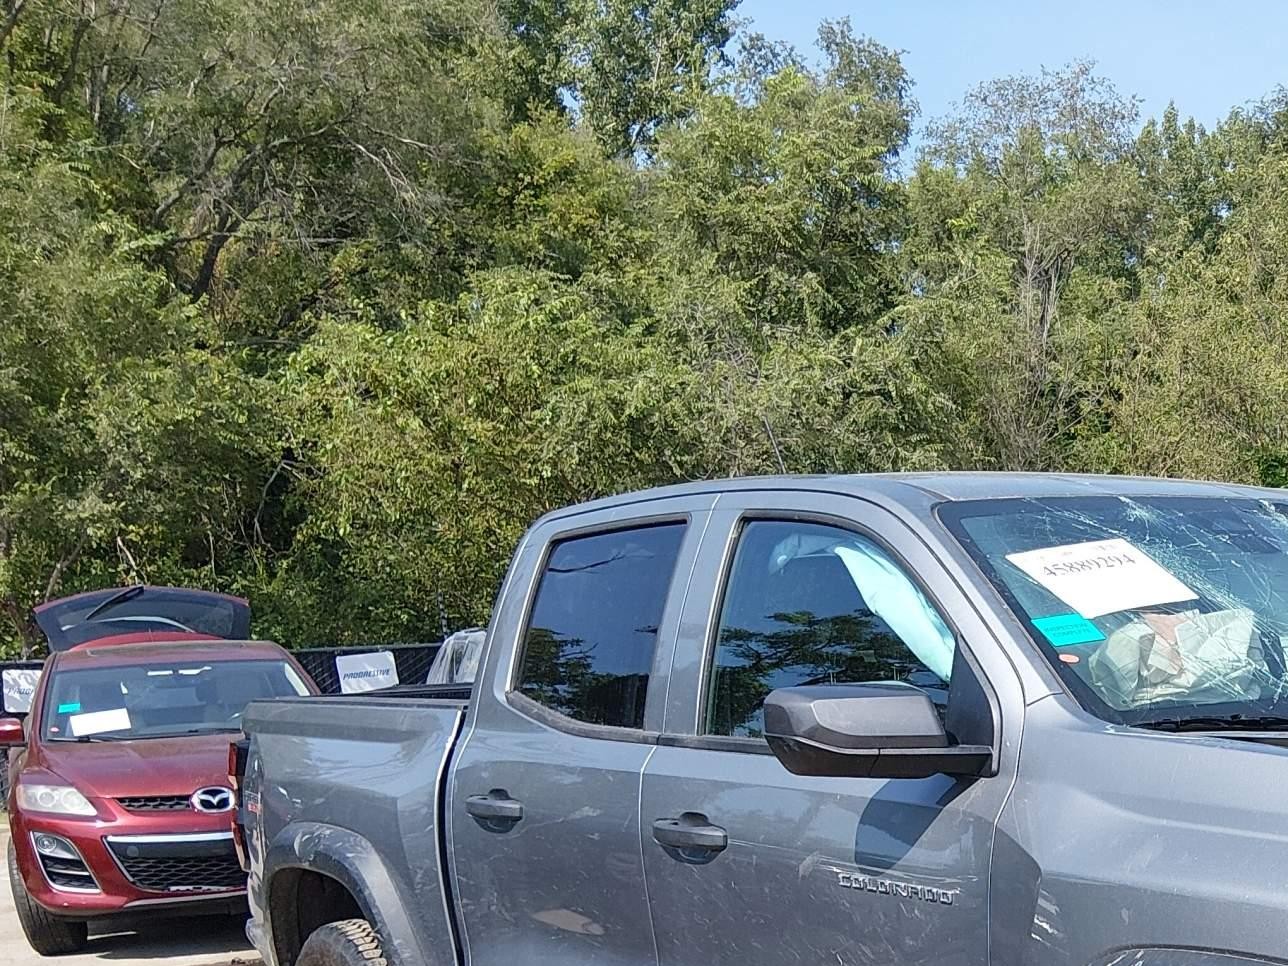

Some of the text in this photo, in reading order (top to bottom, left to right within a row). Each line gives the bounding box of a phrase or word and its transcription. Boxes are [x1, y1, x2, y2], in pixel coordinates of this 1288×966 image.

[1043, 553, 1136, 576] 45889294
[343, 668, 390, 681] PROGRESSIVE
[837, 872, 955, 904] COLORADO
